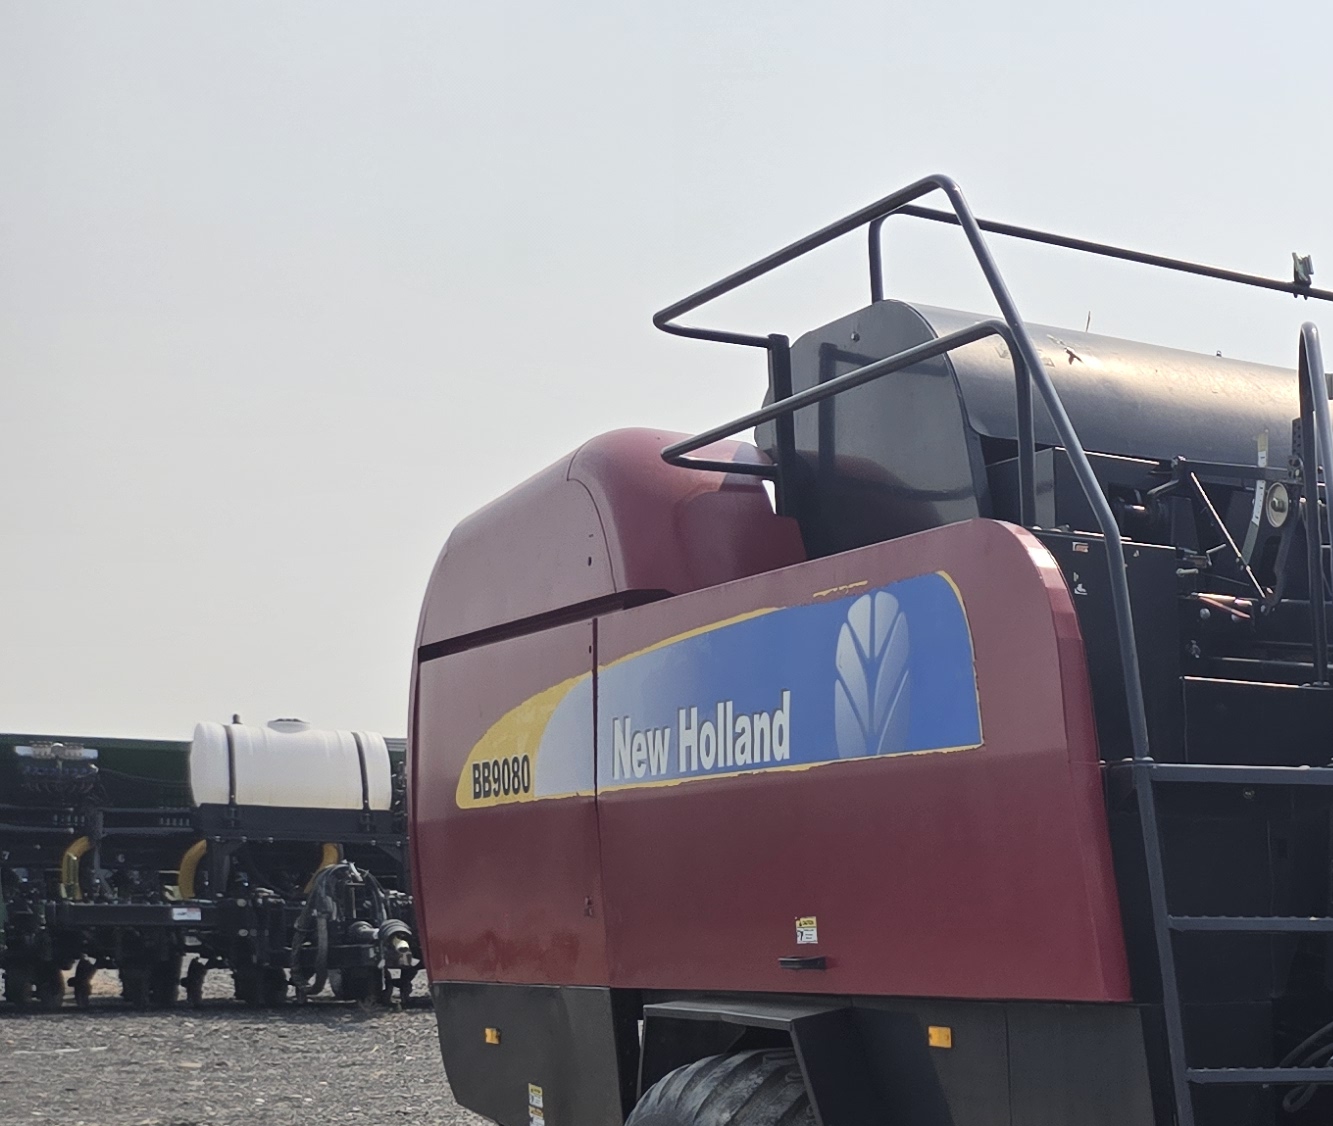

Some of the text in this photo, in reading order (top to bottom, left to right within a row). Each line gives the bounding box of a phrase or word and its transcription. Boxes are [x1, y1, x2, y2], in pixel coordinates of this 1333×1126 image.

[613, 689, 791, 780] New Holland
[472, 754, 531, 800] BB9080
